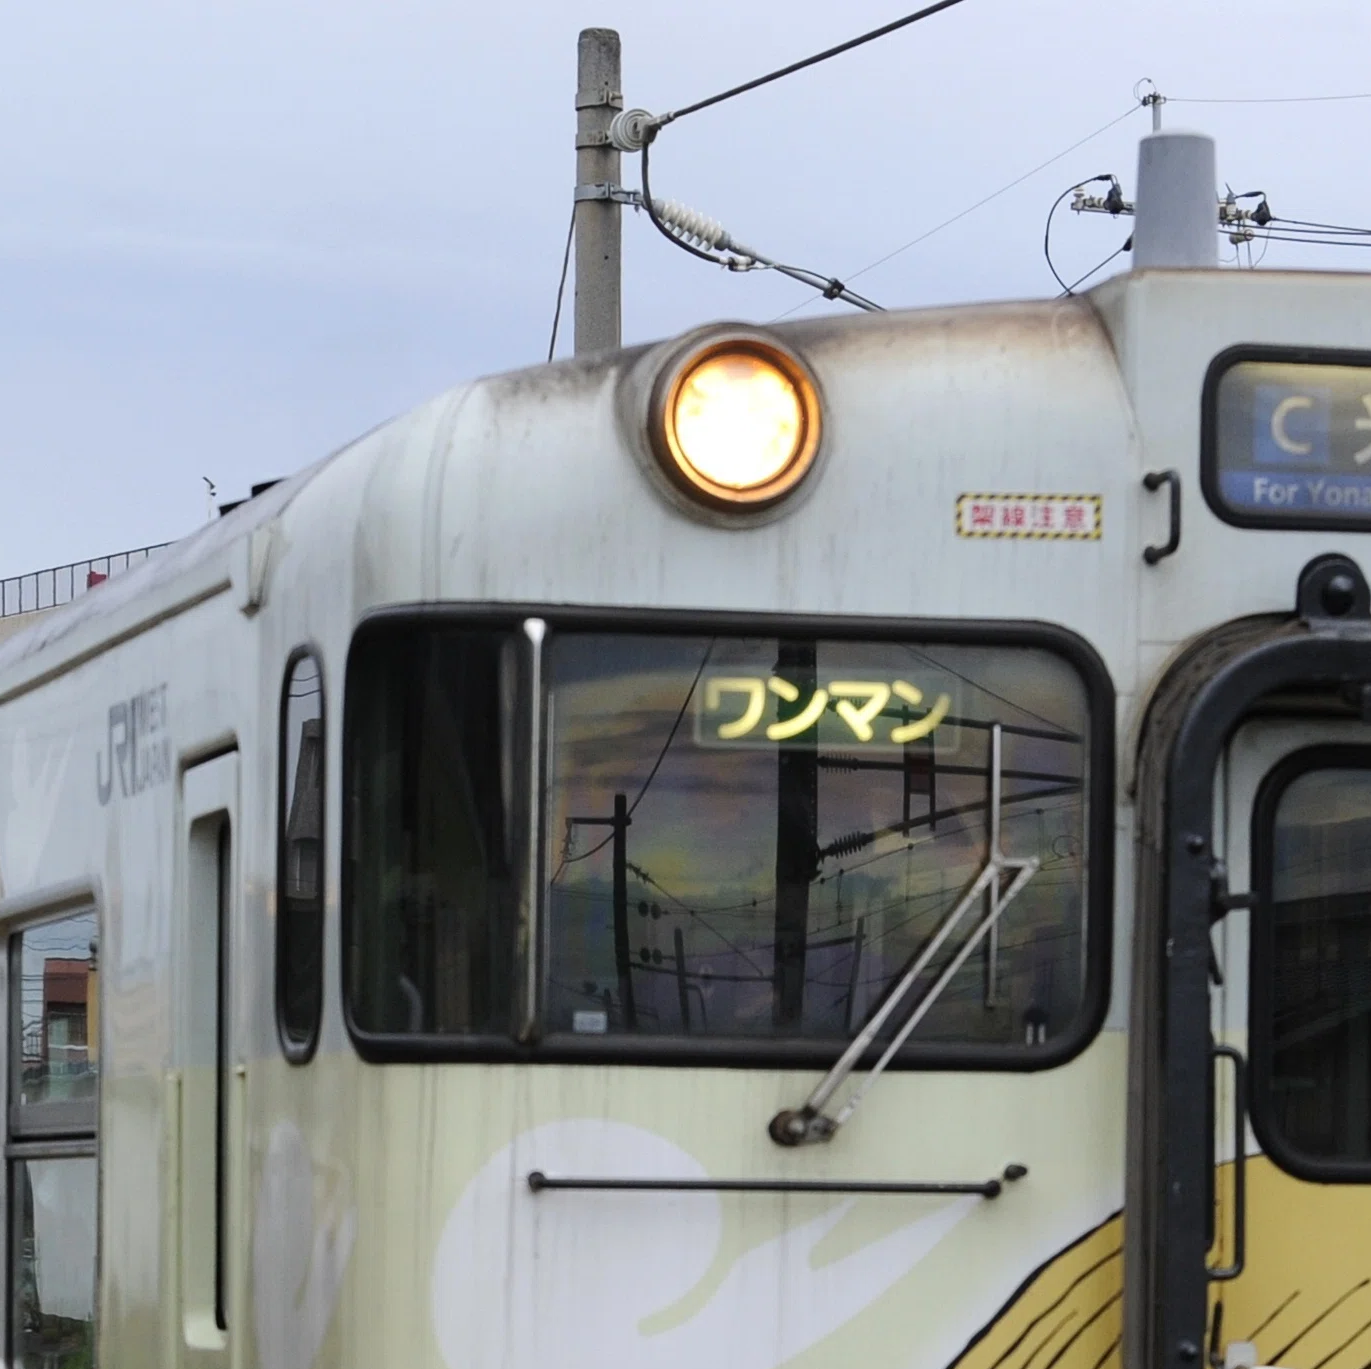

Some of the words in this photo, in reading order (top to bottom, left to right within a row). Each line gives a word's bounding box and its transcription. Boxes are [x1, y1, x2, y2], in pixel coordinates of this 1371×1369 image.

[1270, 395, 1312, 455] C
[1253, 476, 1299, 505] For
[705, 676, 951, 744] ワンマン
